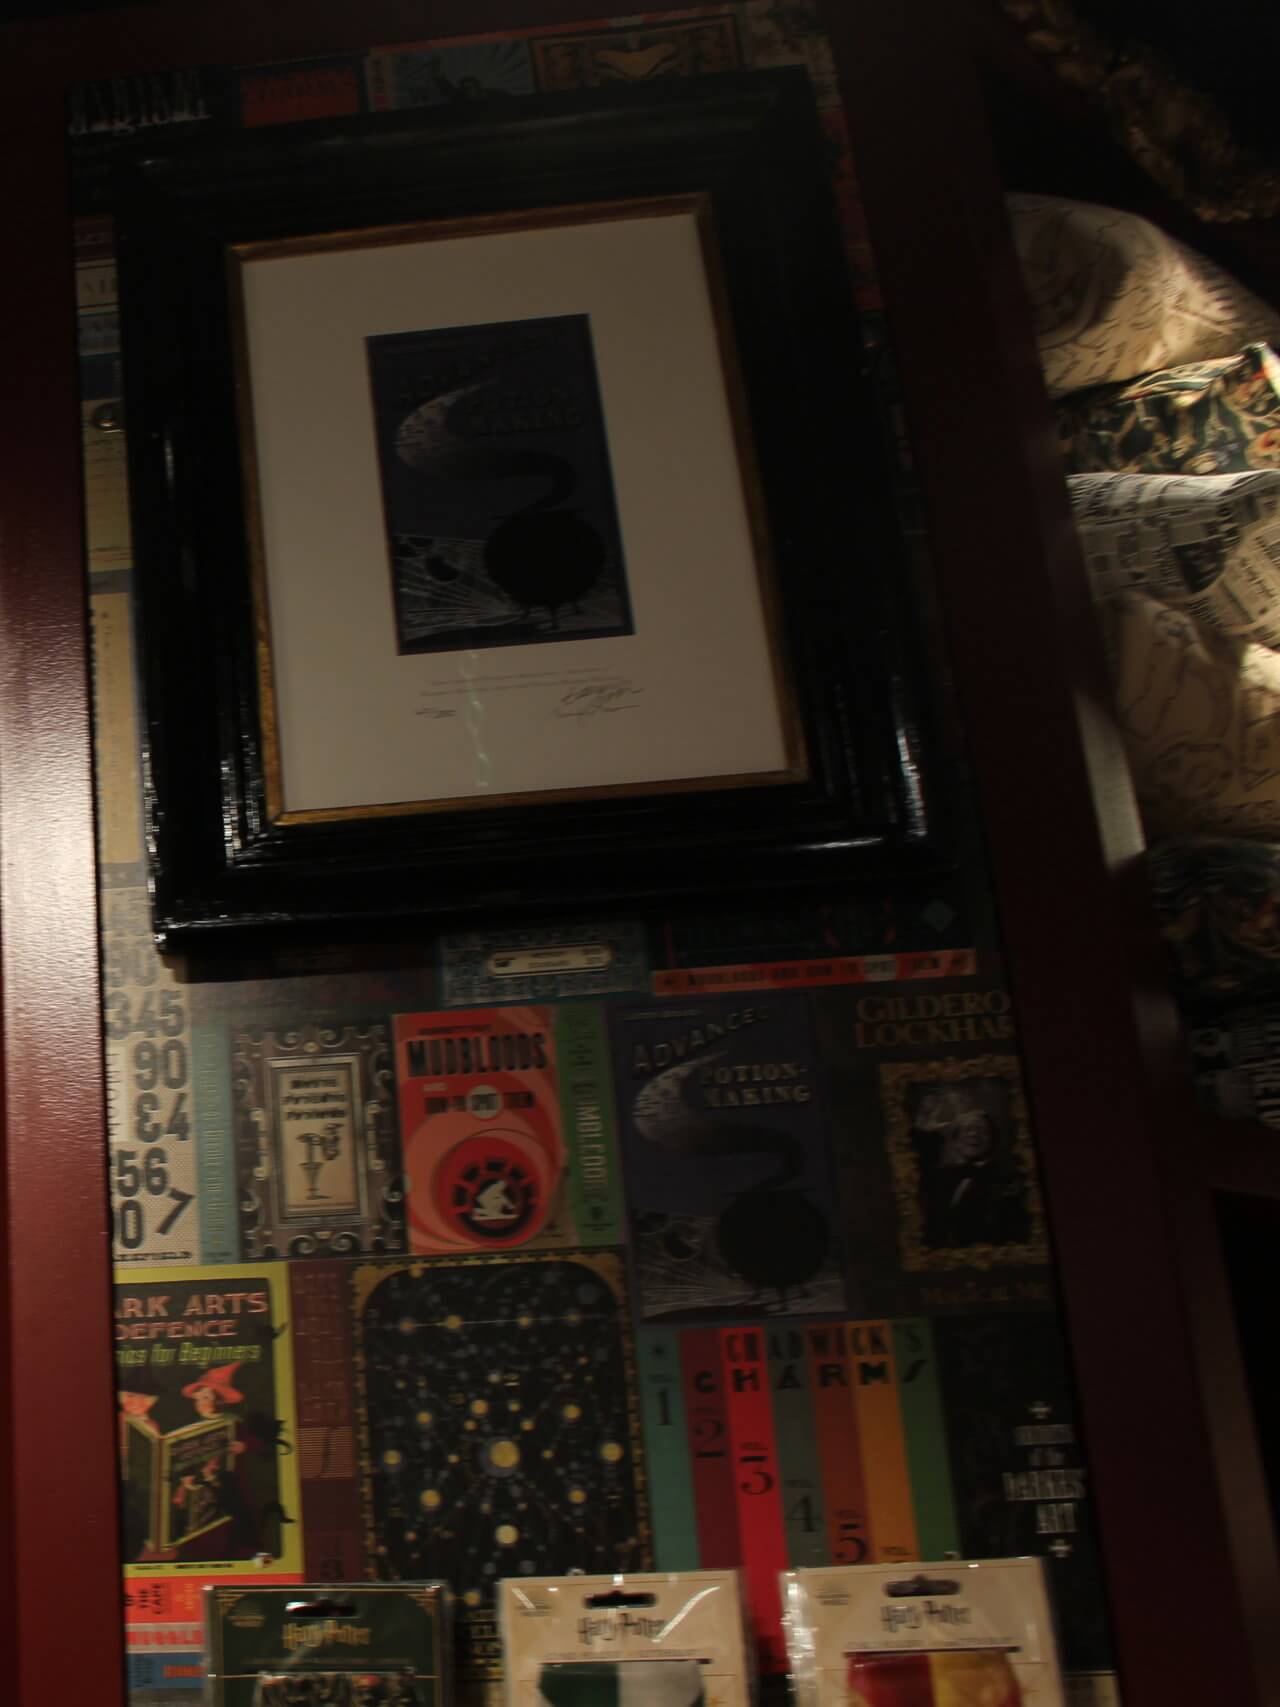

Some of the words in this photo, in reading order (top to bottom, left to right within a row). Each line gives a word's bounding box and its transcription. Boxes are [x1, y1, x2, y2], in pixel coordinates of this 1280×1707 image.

[181, 1290, 269, 1319] ARTS
[695, 1358, 928, 1395] CHARMS
[577, 1612, 619, 1646] Harry
